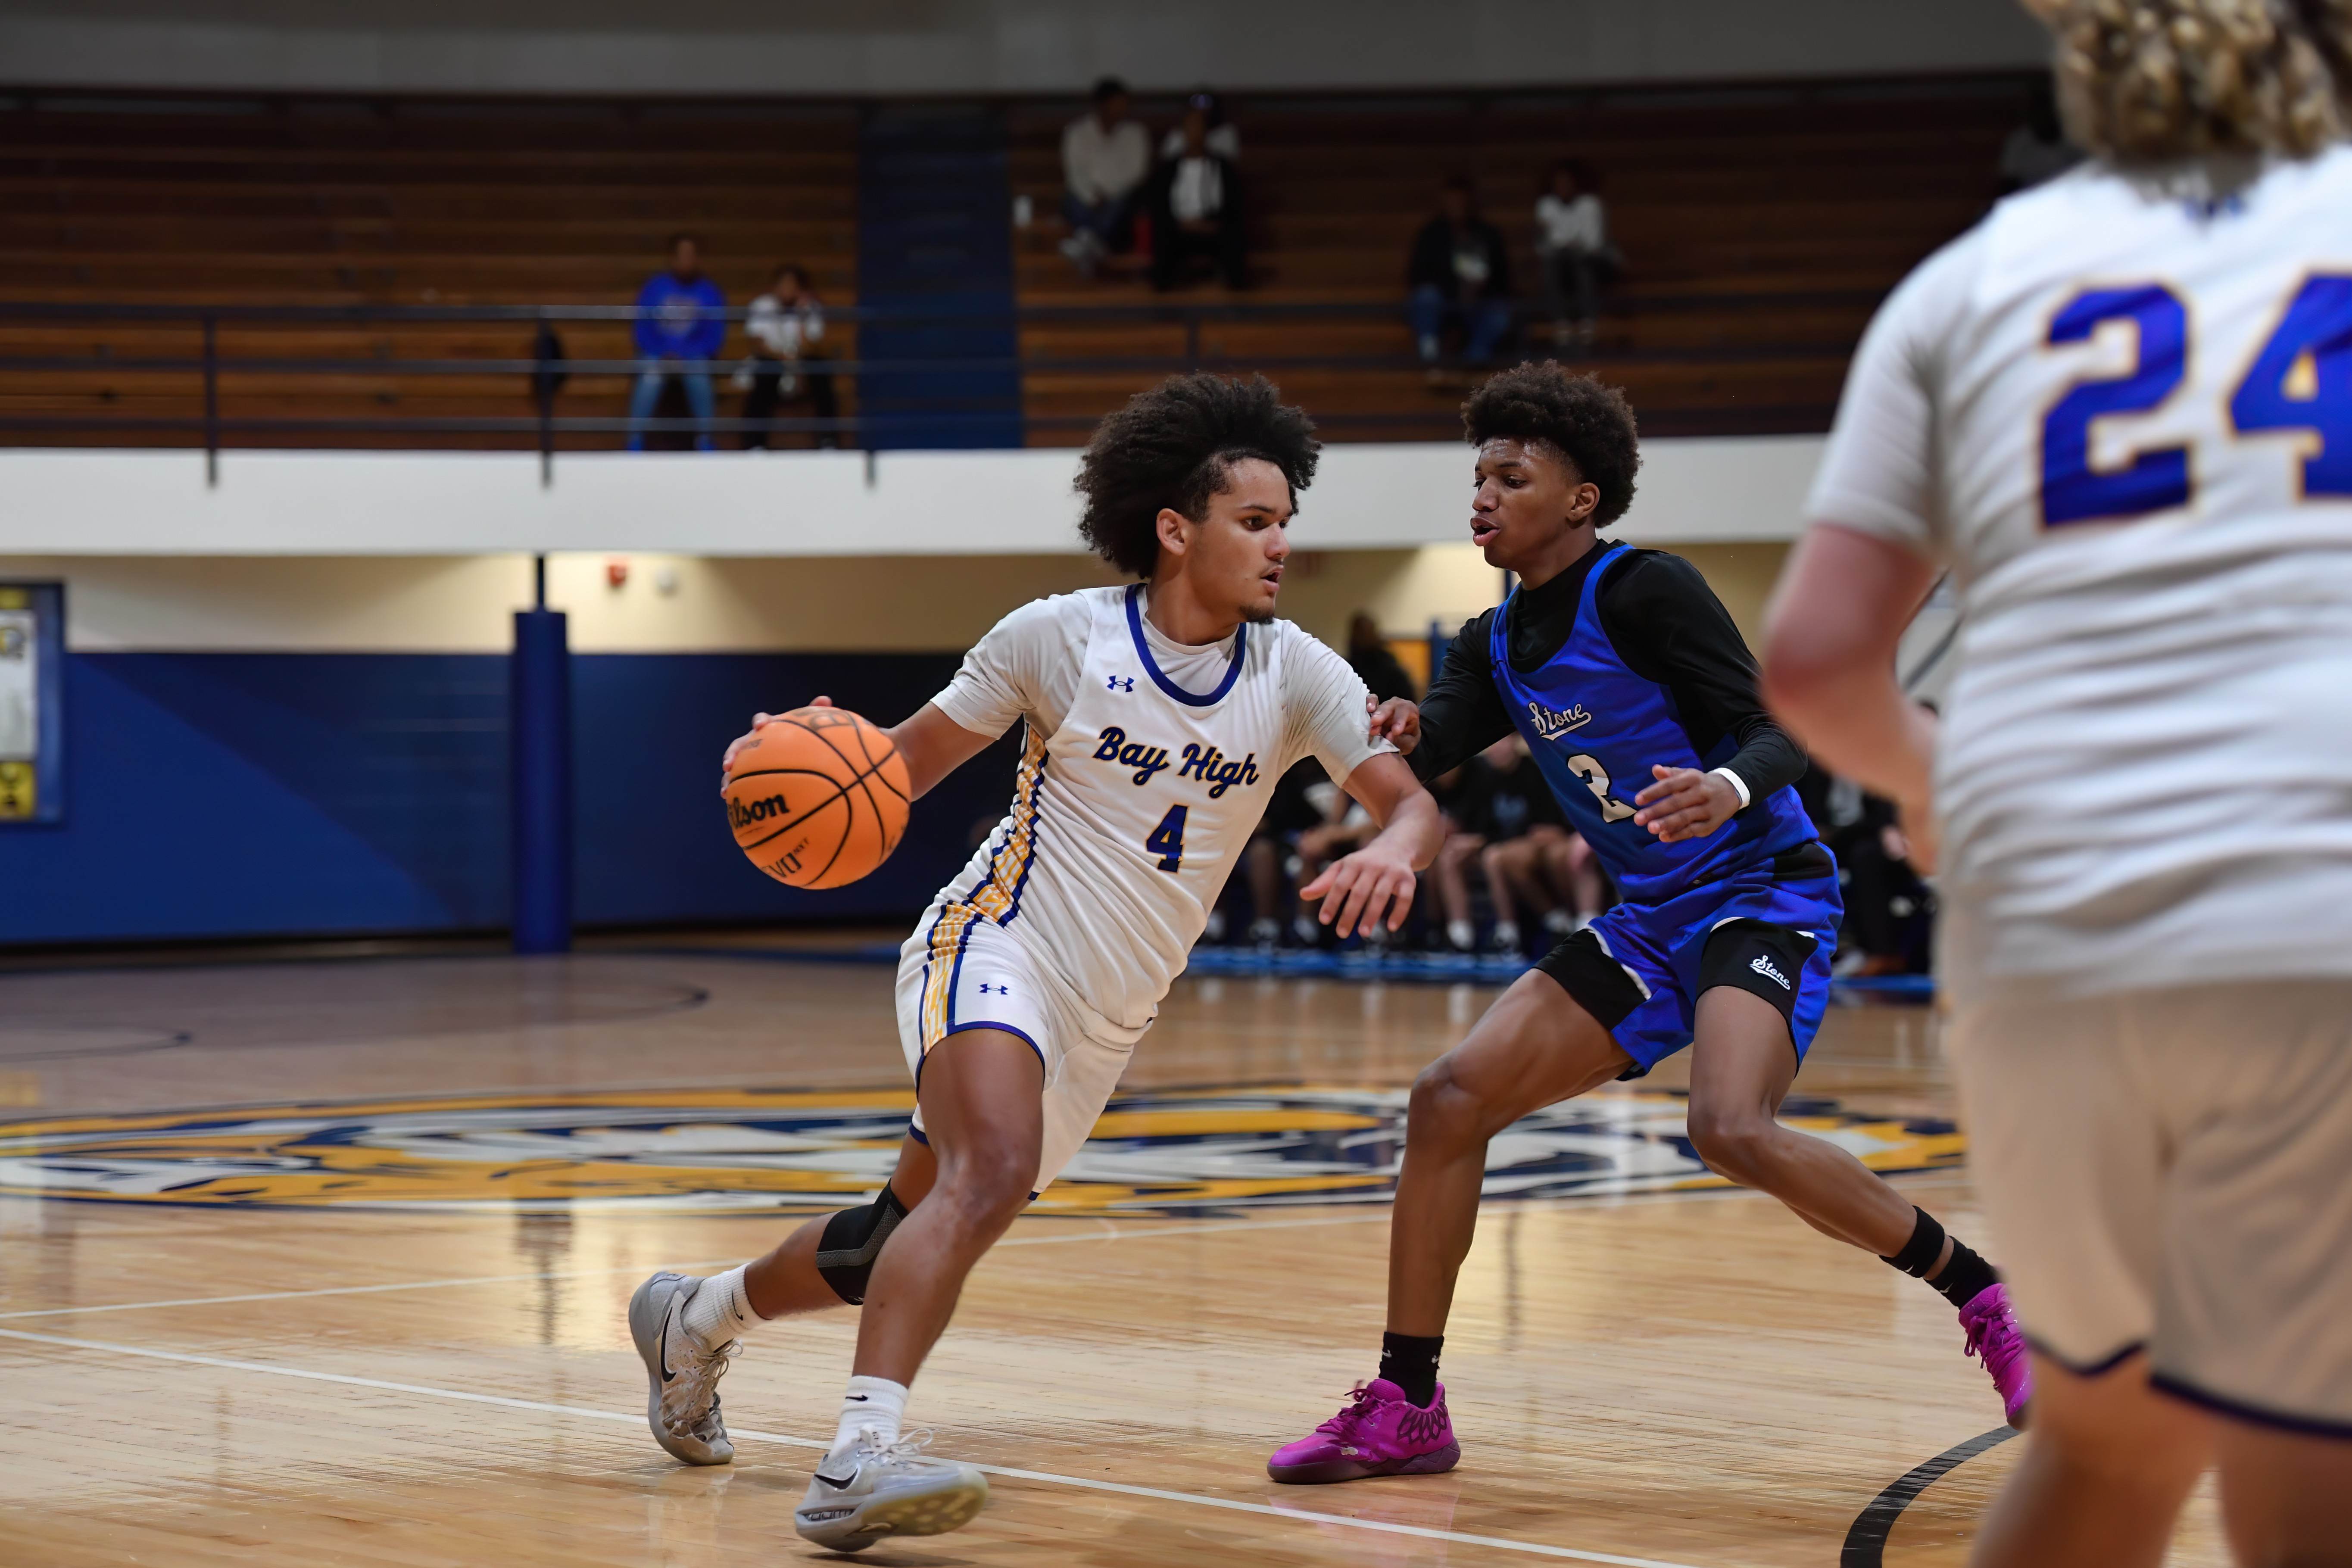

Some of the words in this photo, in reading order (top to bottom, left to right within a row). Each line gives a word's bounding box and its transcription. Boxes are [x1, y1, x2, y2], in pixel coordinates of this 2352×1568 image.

[2035, 271, 2352, 533] 24
[1529, 702, 1591, 741] Stone
[1092, 726, 1170, 786] Bay
[1177, 743, 1260, 799] High
[1567, 752, 1638, 824] 2
[728, 795, 790, 829] lson
[1145, 803, 1190, 874] 4
[1750, 955, 1791, 990] Stone
